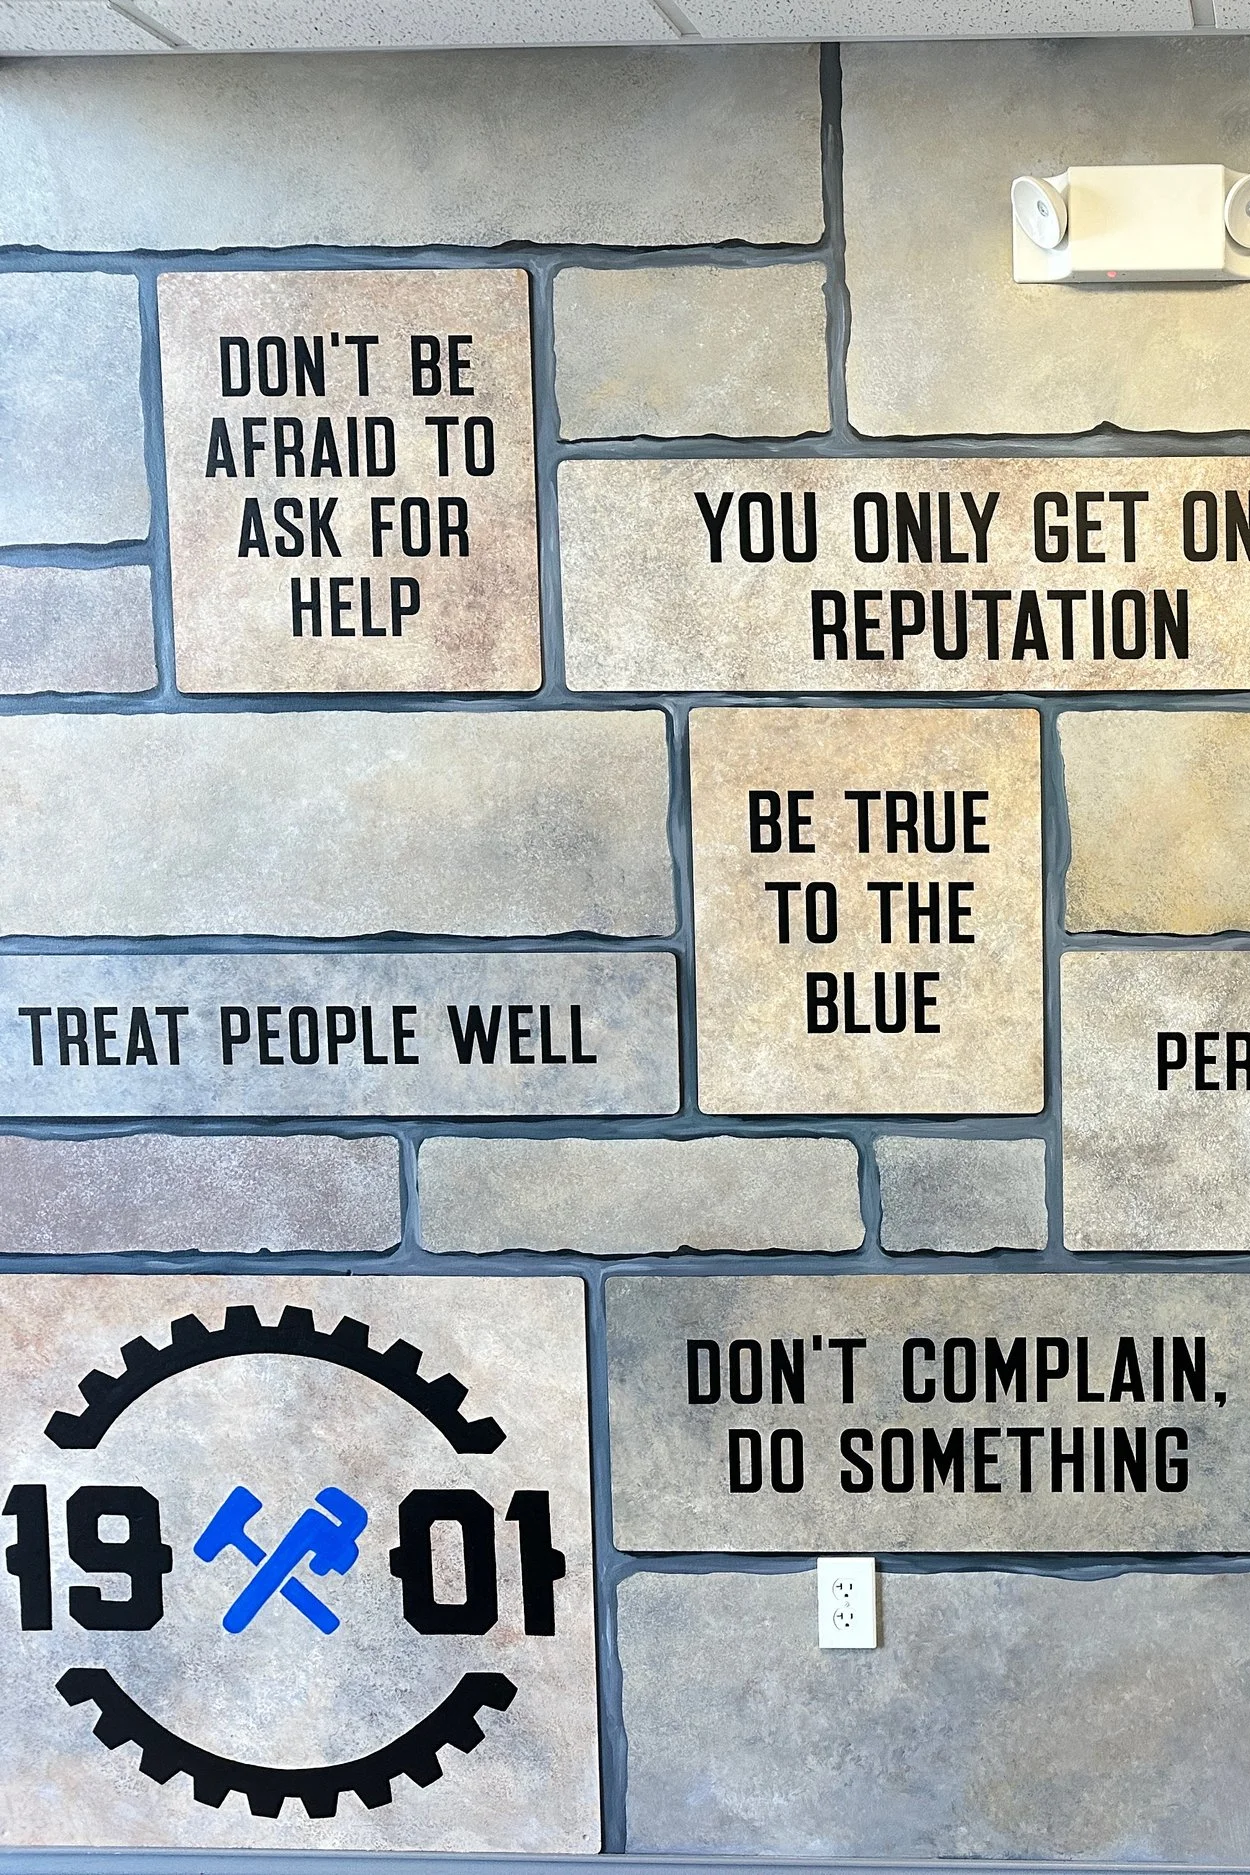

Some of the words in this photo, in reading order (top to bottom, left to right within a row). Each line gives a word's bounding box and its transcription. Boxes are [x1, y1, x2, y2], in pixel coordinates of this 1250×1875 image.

[220, 332, 379, 397] DON'T
[411, 335, 474, 396] BE
[205, 417, 395, 477] AFRAID
[425, 416, 494, 476] TO
[238, 497, 342, 557] ASK
[371, 497, 469, 557] FOR
[694, 492, 817, 562] YOU
[854, 492, 1000, 563] ONLY
[1034, 491, 1149, 563] GET
[291, 577, 420, 637] HELP
[811, 589, 1188, 660] REPUTATION
[749, 791, 815, 853] BE
[845, 791, 989, 853] TRUE
[765, 882, 837, 943] TO
[867, 882, 974, 943] THE
[807, 972, 940, 1033] BLUE
[18, 1007, 189, 1065] TREAT
[221, 1006, 419, 1065] PEOPLE
[447, 1005, 597, 1064] WELL
[687, 1335, 866, 1404] DON'T
[903, 1337, 1226, 1407] COMPLAIN,
[729, 1429, 803, 1493] DO
[841, 1427, 1188, 1493] SOMETHING
[2, 1484, 173, 1631] 19
[389, 1489, 566, 1636] 01
